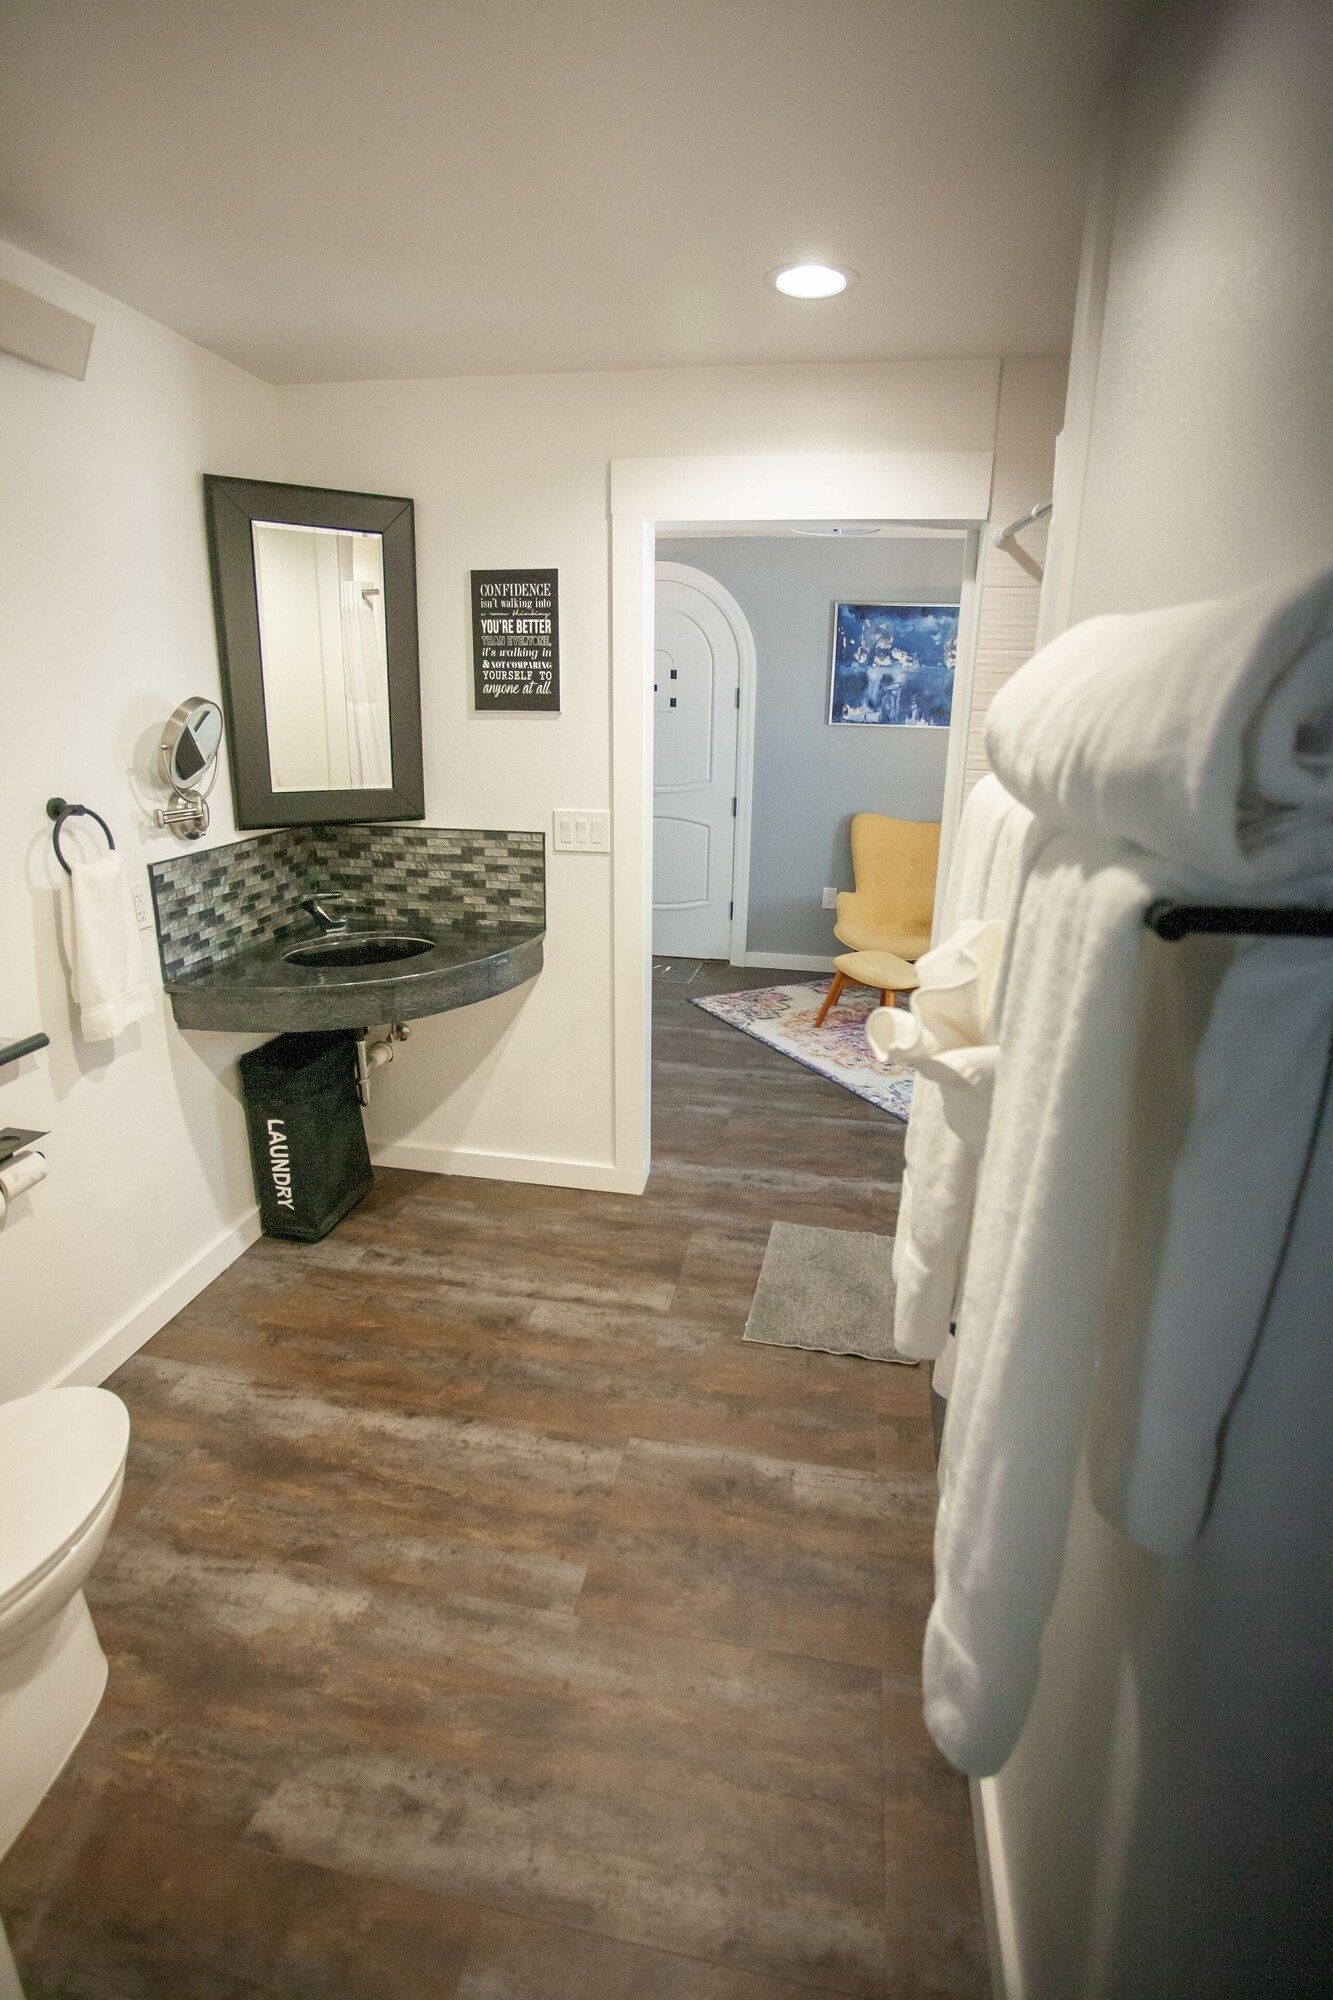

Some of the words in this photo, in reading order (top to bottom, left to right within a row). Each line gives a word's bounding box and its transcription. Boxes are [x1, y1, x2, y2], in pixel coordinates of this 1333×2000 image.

[480, 584, 550, 596] CONFIDENCE
[481, 598, 498, 608] isn't
[501, 598, 532, 609] walking
[536, 598, 551, 608] into
[481, 620, 514, 634] YOU'RE
[517, 620, 551, 634] BETTER
[482, 636, 505, 646] THAN
[507, 636, 552, 647] EVERYONE,
[482, 648, 496, 657] it's
[500, 648, 538, 660] walking
[542, 648, 551, 657] in
[482, 660, 490, 668] &
[483, 671, 533, 680] YOURSELF
[540, 671, 552, 680] TO
[483, 683, 520, 698] anyone
[522, 681, 534, 694] at
[536, 681, 552, 694] all.
[267, 1119, 294, 1211] LAUNDRY
